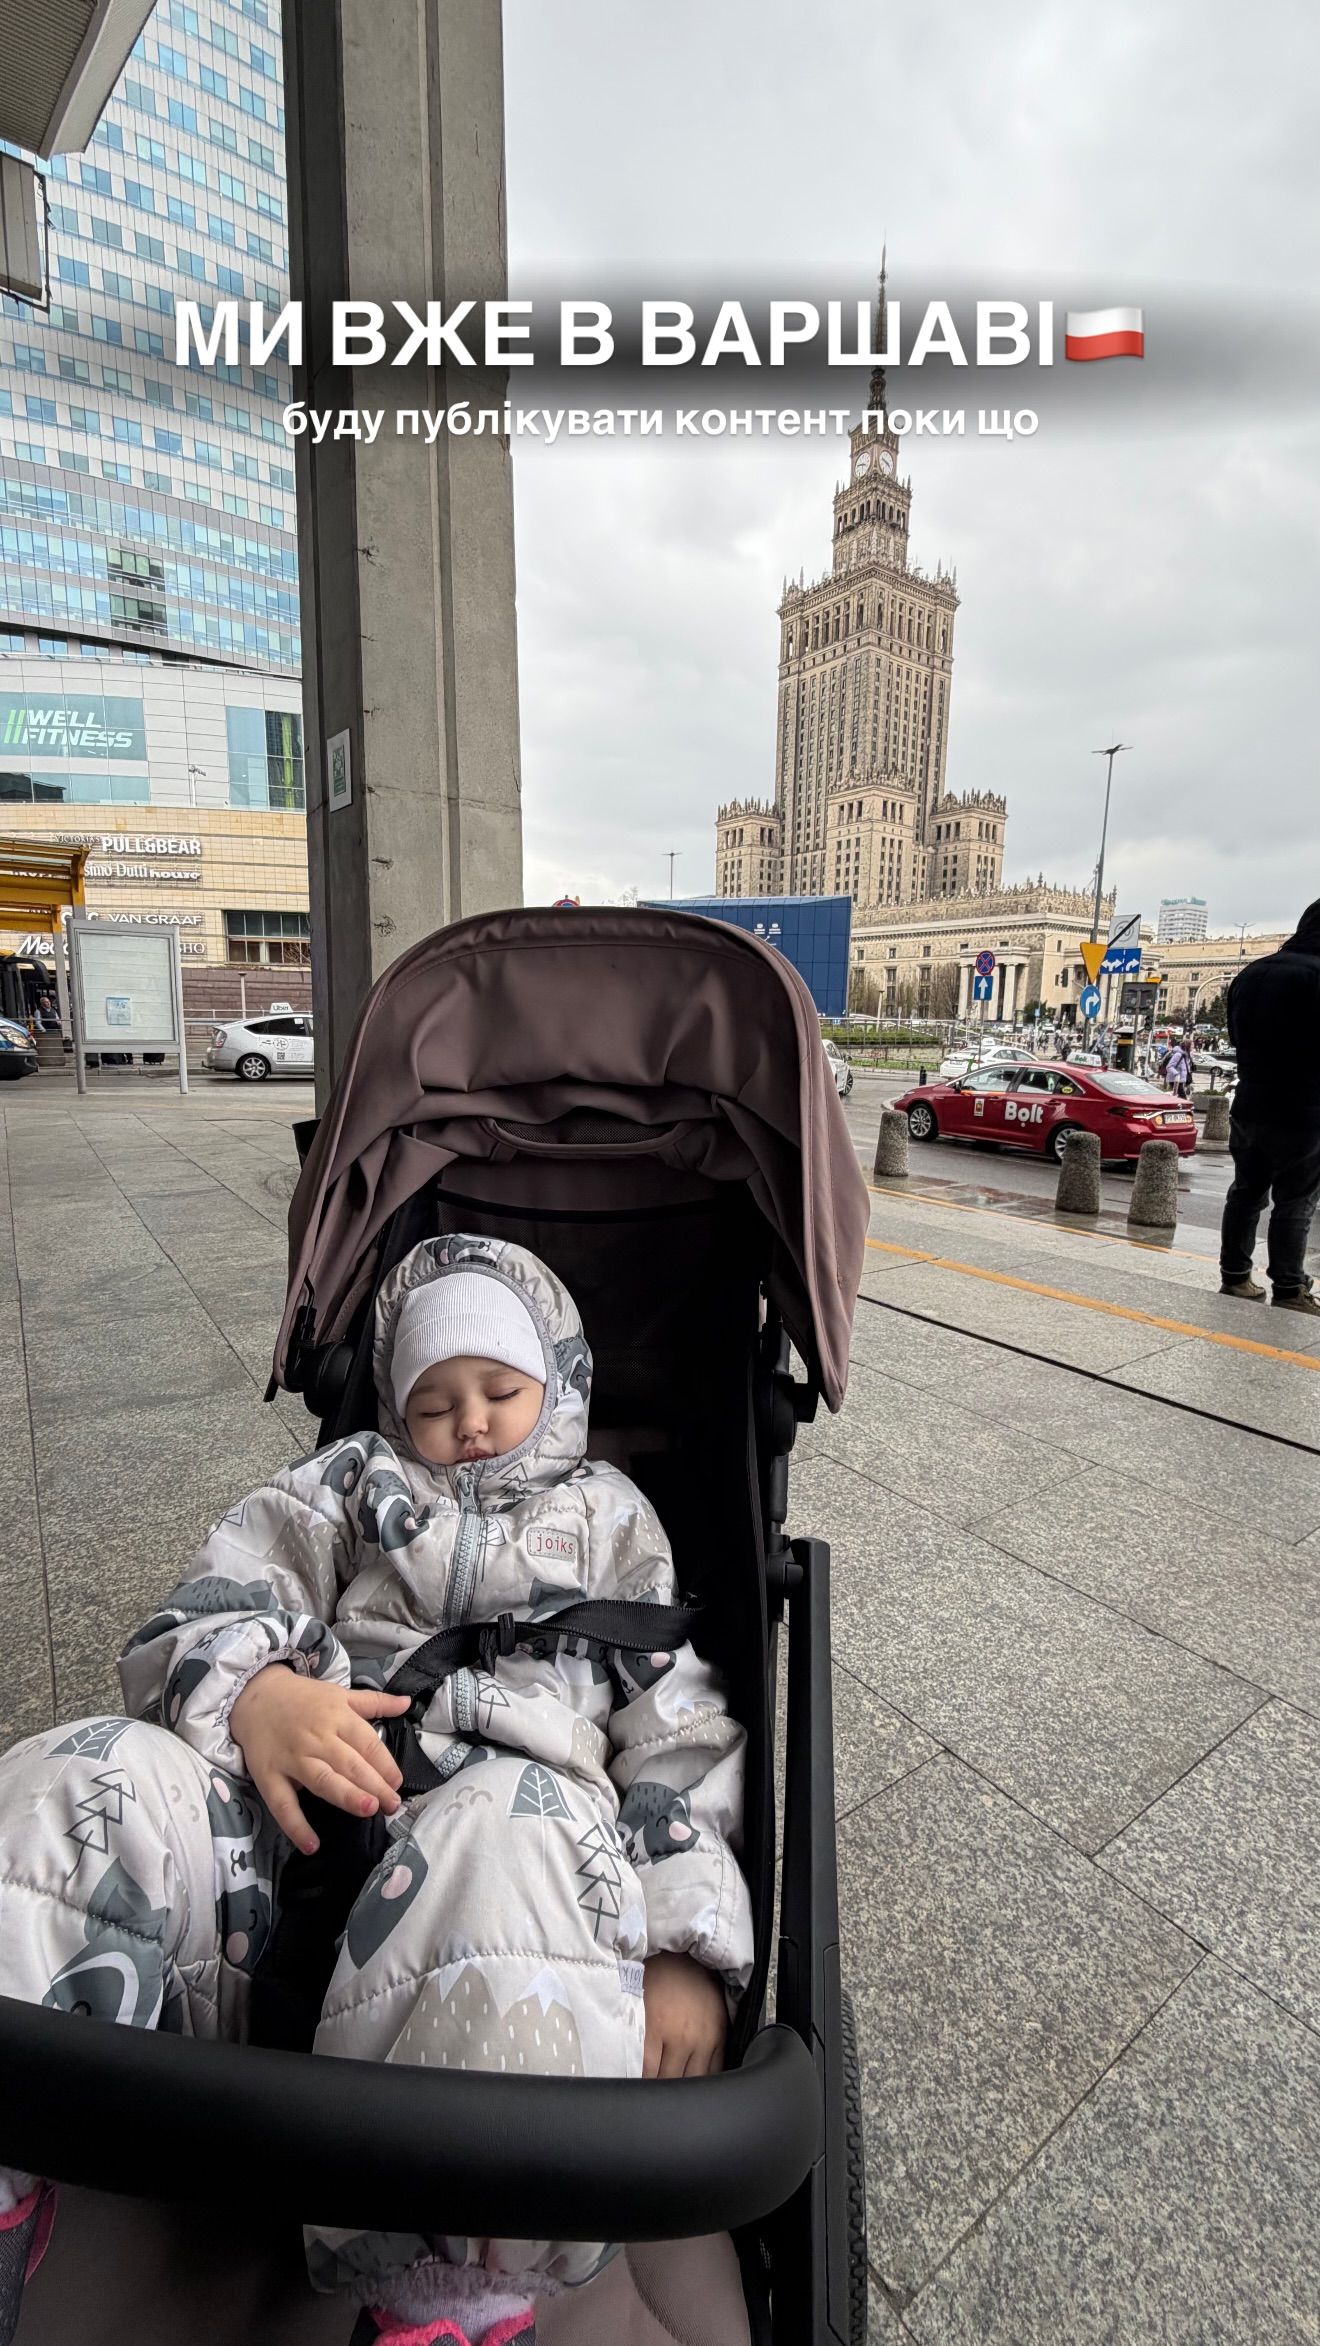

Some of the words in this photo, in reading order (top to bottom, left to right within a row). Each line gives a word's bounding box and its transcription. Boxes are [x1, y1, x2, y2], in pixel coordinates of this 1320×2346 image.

[28, 709, 102, 728] WELL
[21, 727, 134, 748] FITNESS
[102, 836, 201, 855] PULL&BEAR
[116, 861, 148, 878] Dutti
[108, 913, 141, 924] VAN
[145, 914, 202, 925] GRAAF
[1004, 1101, 1044, 1127] Bolt
[537, 1533, 574, 1555] joiks
